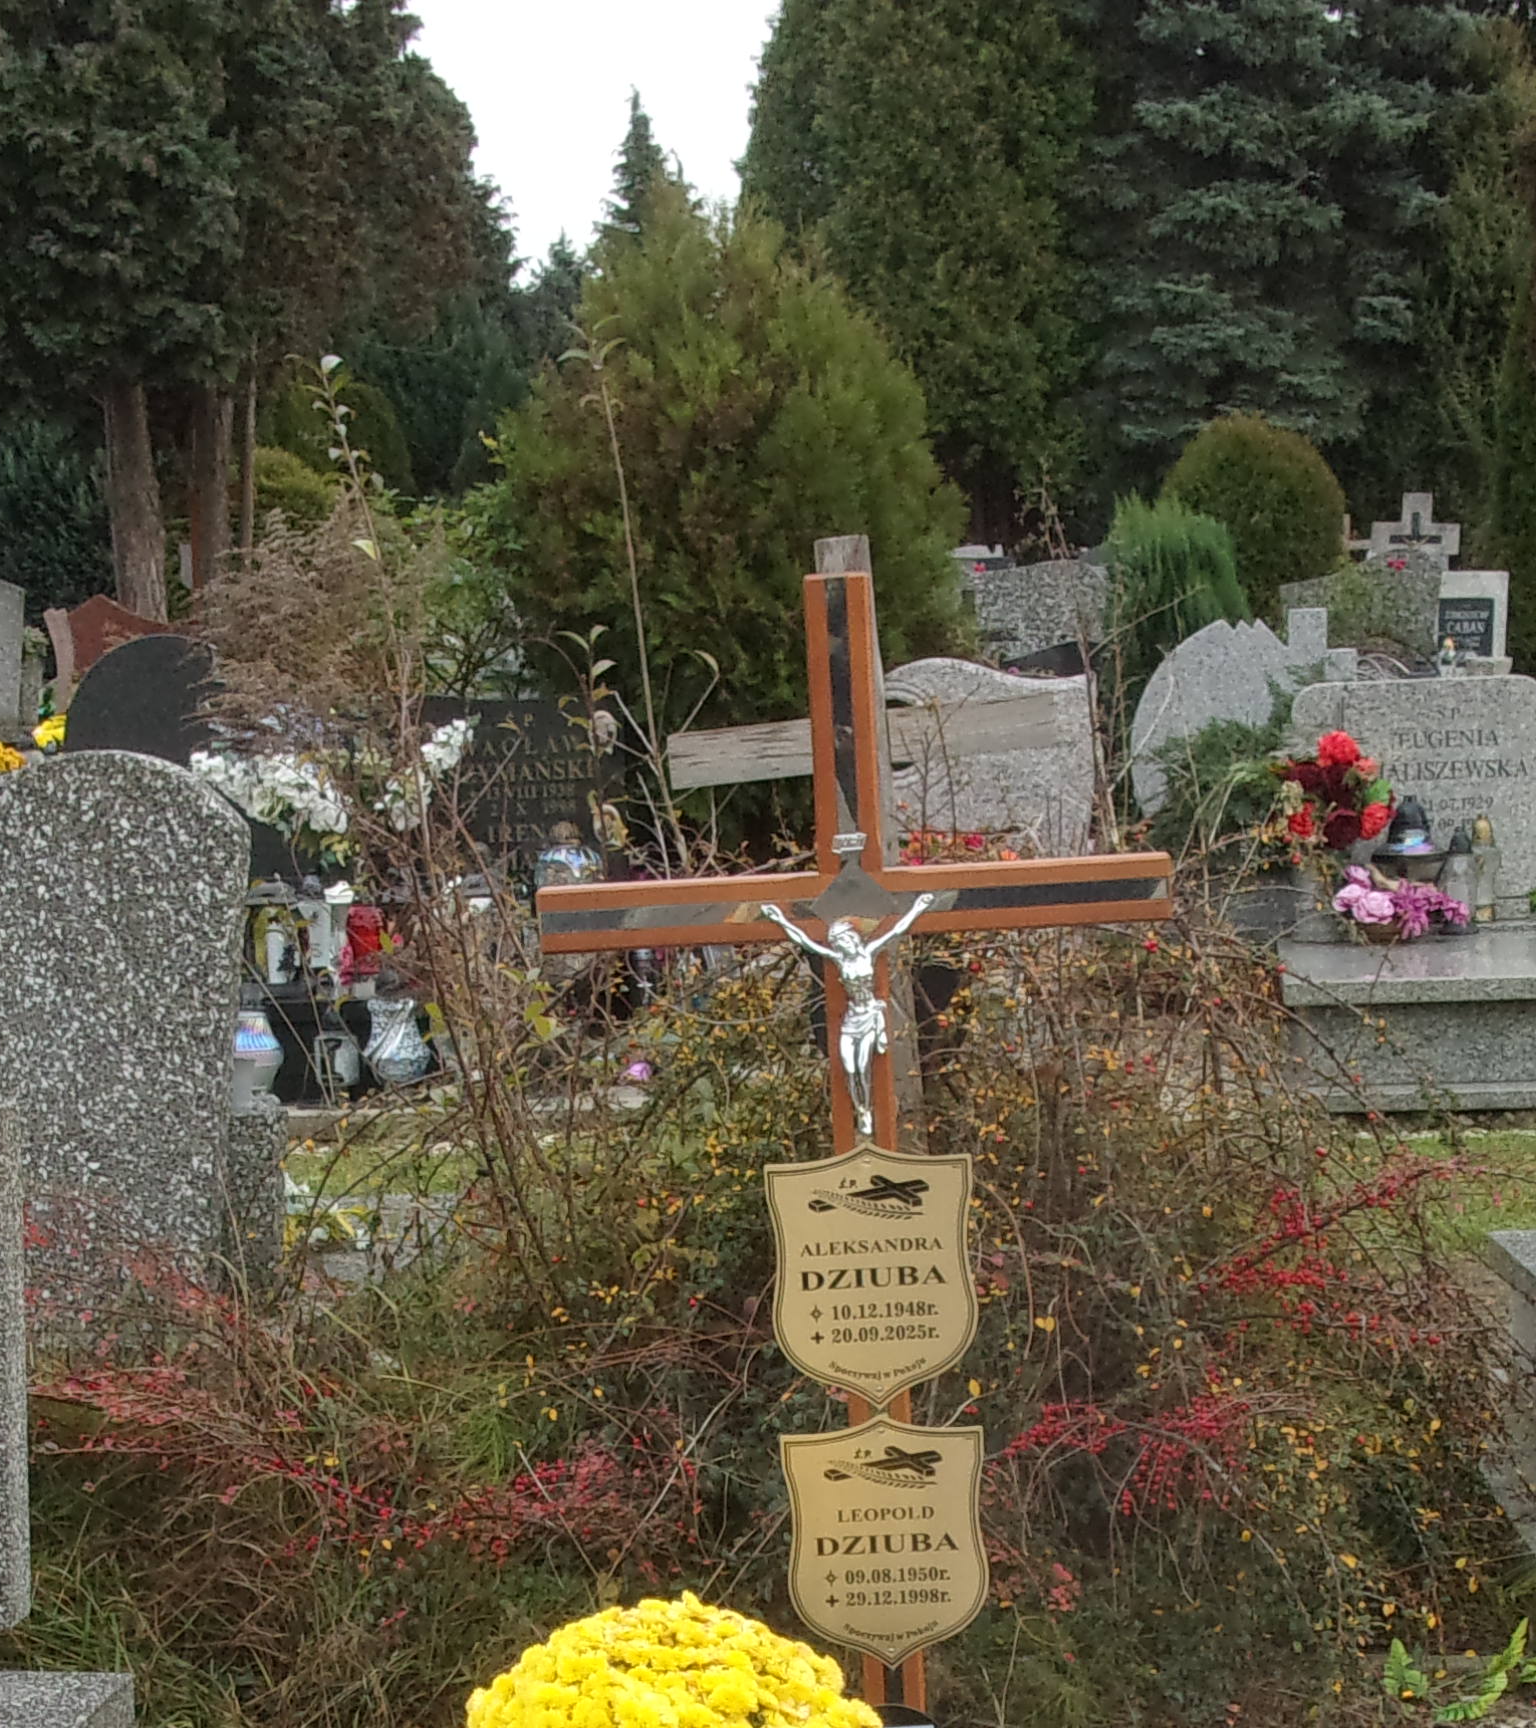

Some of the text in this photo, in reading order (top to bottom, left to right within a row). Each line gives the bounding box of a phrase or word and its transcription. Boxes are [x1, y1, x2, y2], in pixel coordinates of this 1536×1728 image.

[465, 734, 585, 757] ACŁAW
[1397, 729, 1501, 750] EUGENIA
[488, 823, 546, 844] IREN
[799, 1236, 945, 1259] ALEKSANDRA
[800, 1264, 947, 1293] DZIUBA
[831, 1300, 940, 1322] 10.12.1948r.
[831, 1324, 940, 1345] 20.09.2025r.
[828, 1360, 882, 1381] Spoczywaj
[837, 1505, 936, 1524] LEOPOLD
[816, 1532, 960, 1558] DZIUBA
[844, 1566, 952, 1586] 09.08.1950r.
[845, 1589, 952, 1608] 29.12.1998r.
